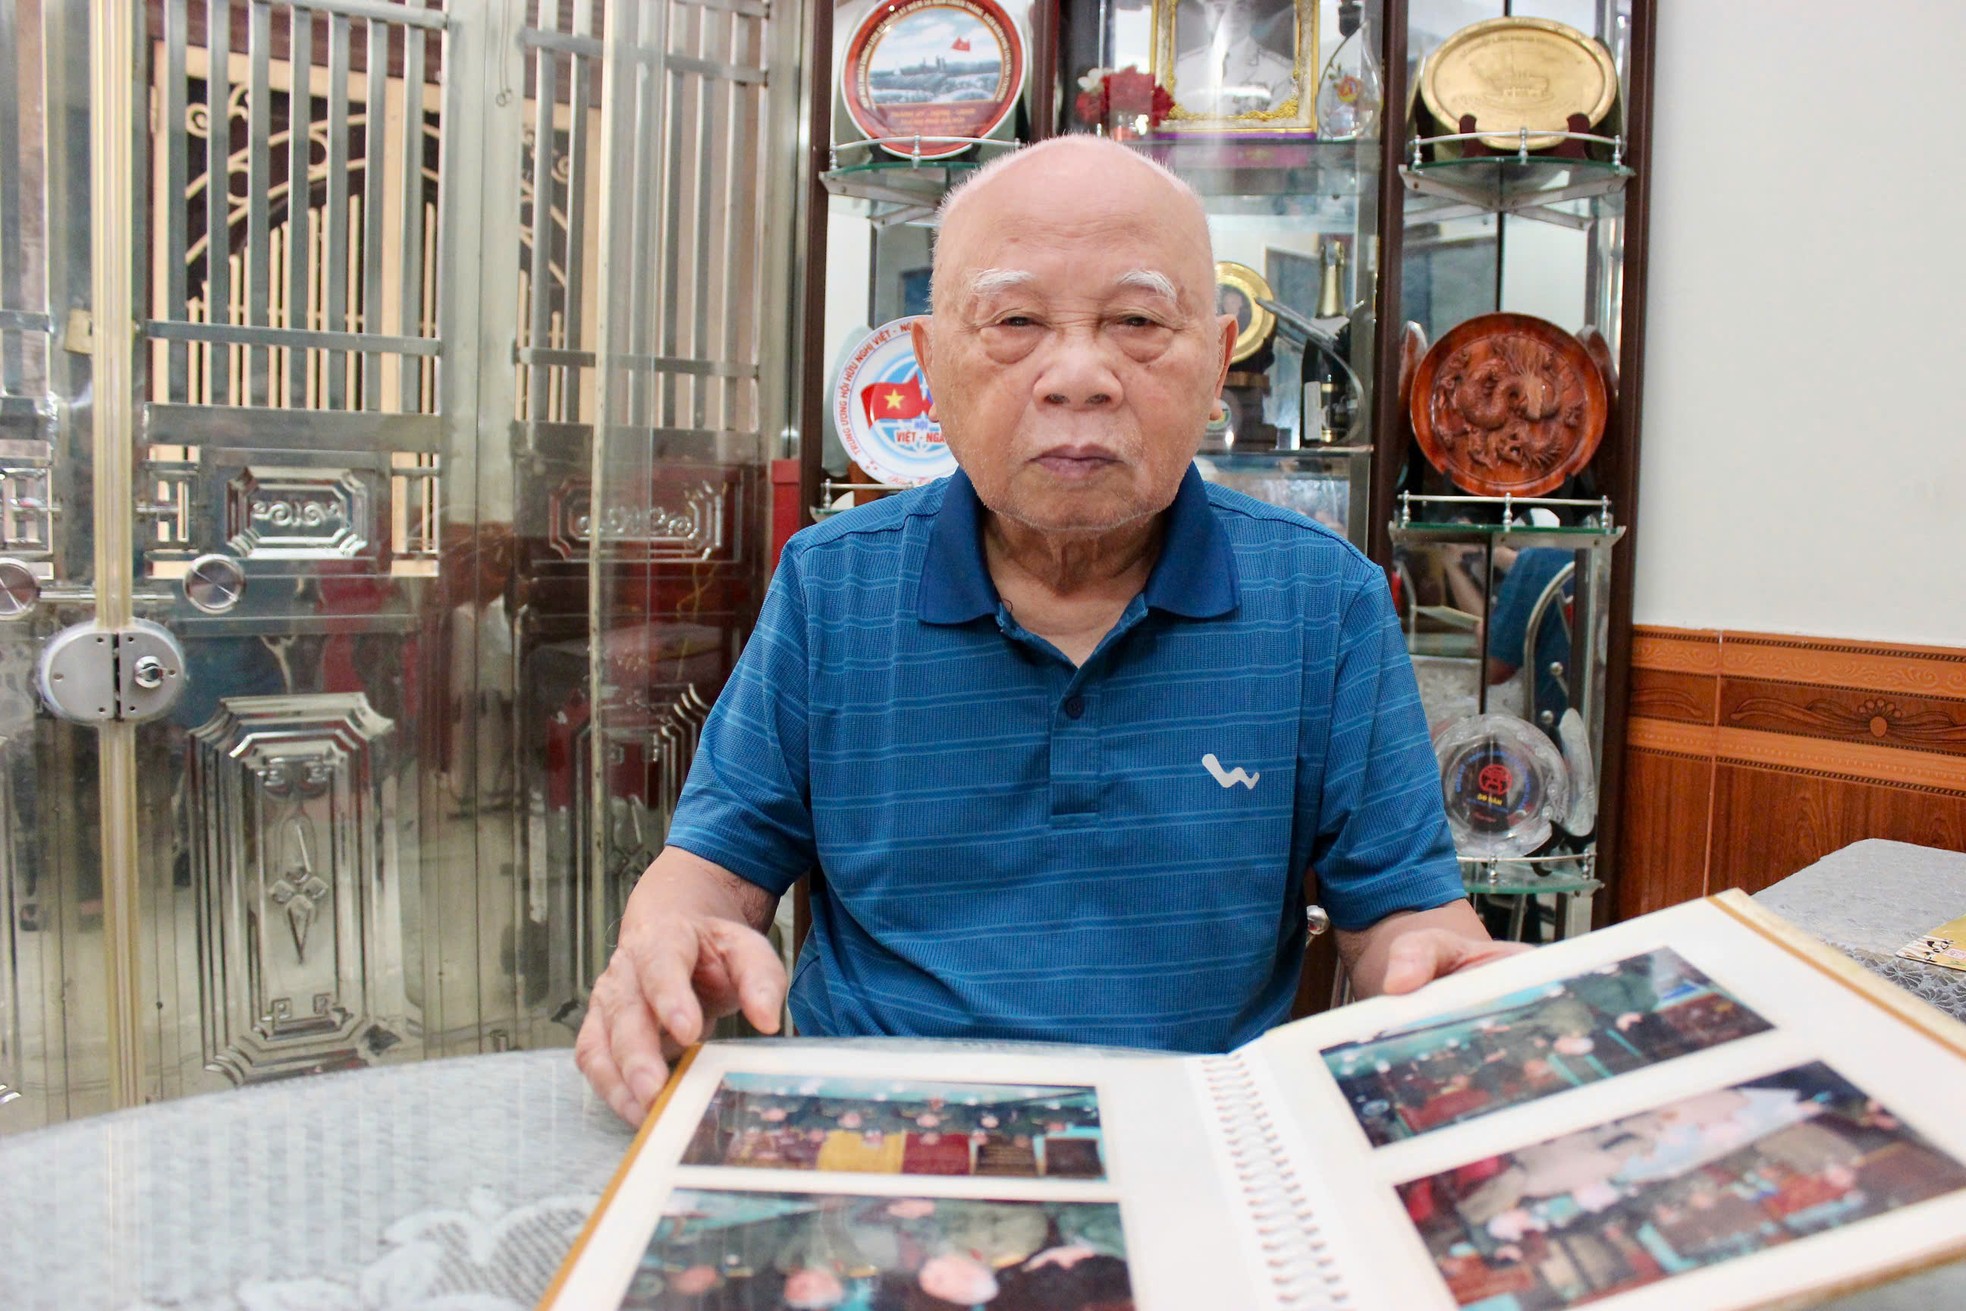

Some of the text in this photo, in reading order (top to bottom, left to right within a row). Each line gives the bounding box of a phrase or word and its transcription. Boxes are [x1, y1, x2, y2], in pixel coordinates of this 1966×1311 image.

[843, 427, 861, 456] TRUNG
[873, 329, 891, 345] VIỆT
[896, 430, 916, 445] VIỆT
[926, 432, 945, 443] NGA
